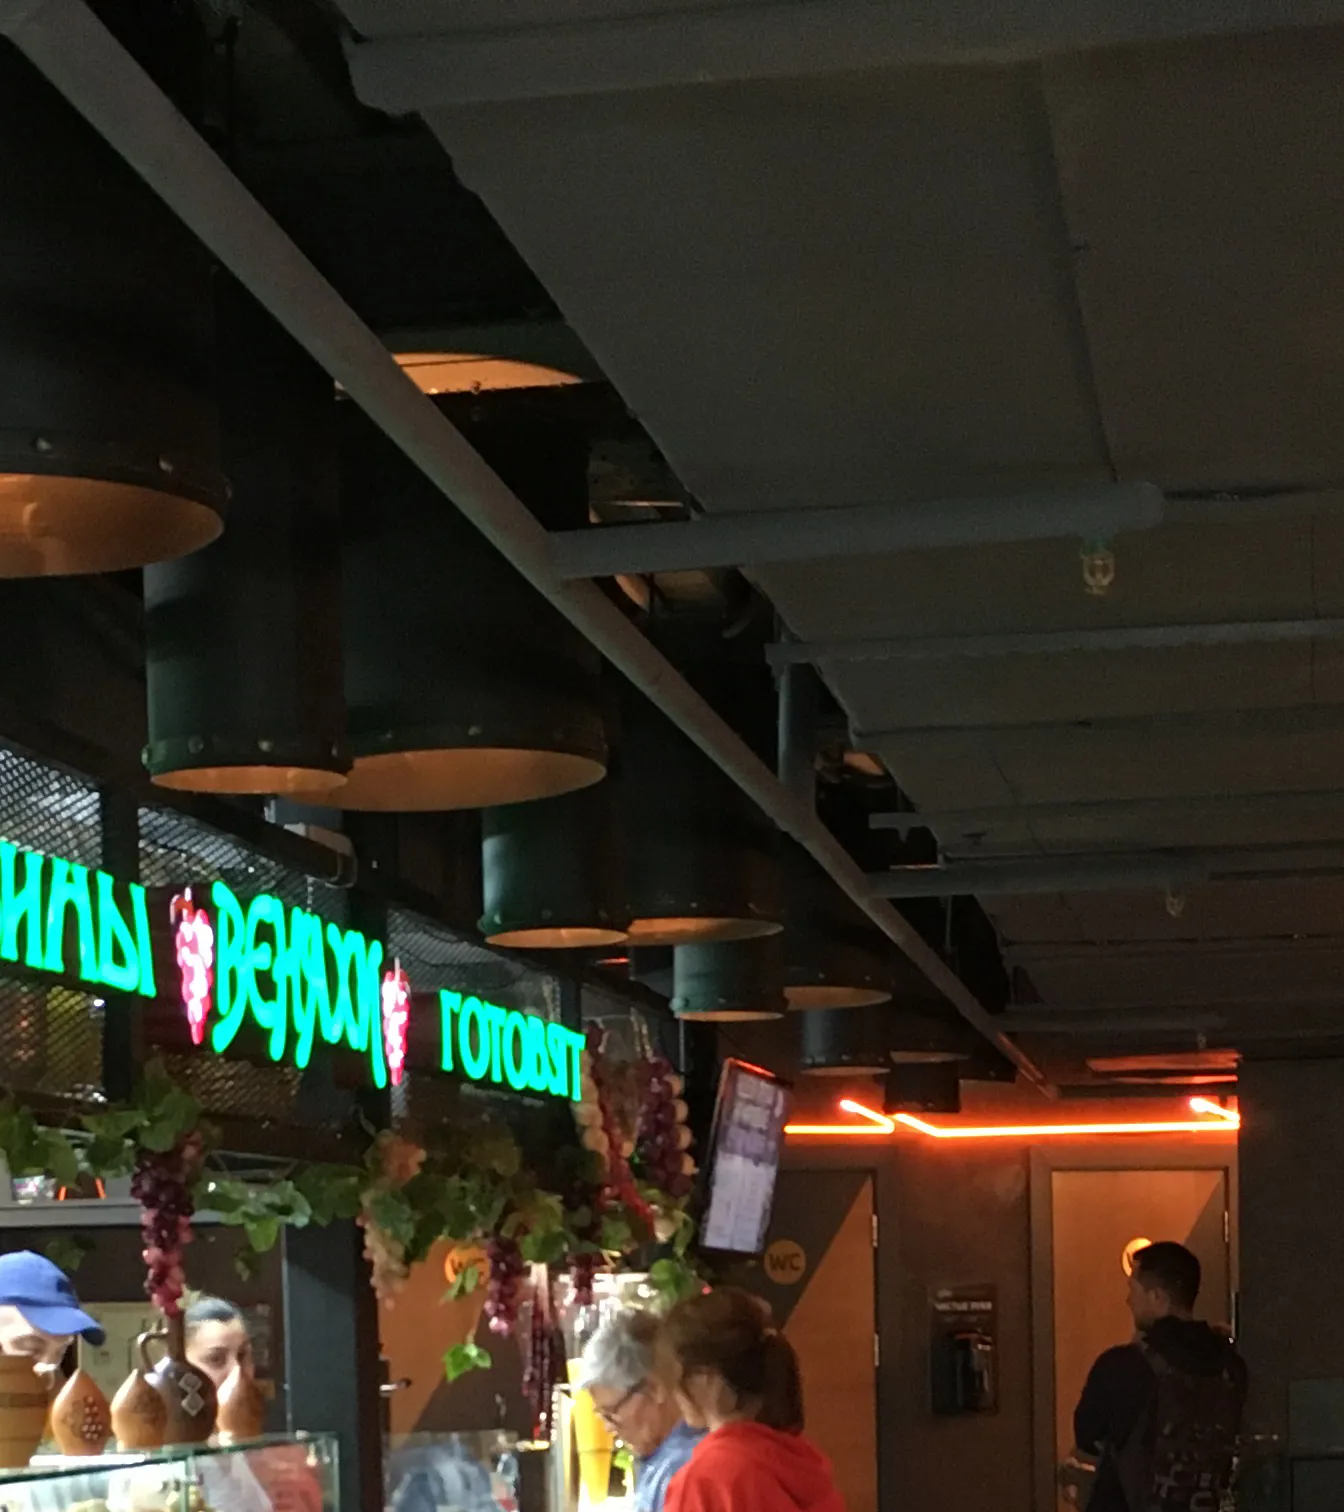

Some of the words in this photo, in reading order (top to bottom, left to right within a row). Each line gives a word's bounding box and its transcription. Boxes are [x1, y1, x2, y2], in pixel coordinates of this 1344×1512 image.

[212, 880, 386, 1089] ВЕНАХИ
[440, 989, 585, 1101] ГОТОВЯТ
[768, 1252, 802, 1271] WC
